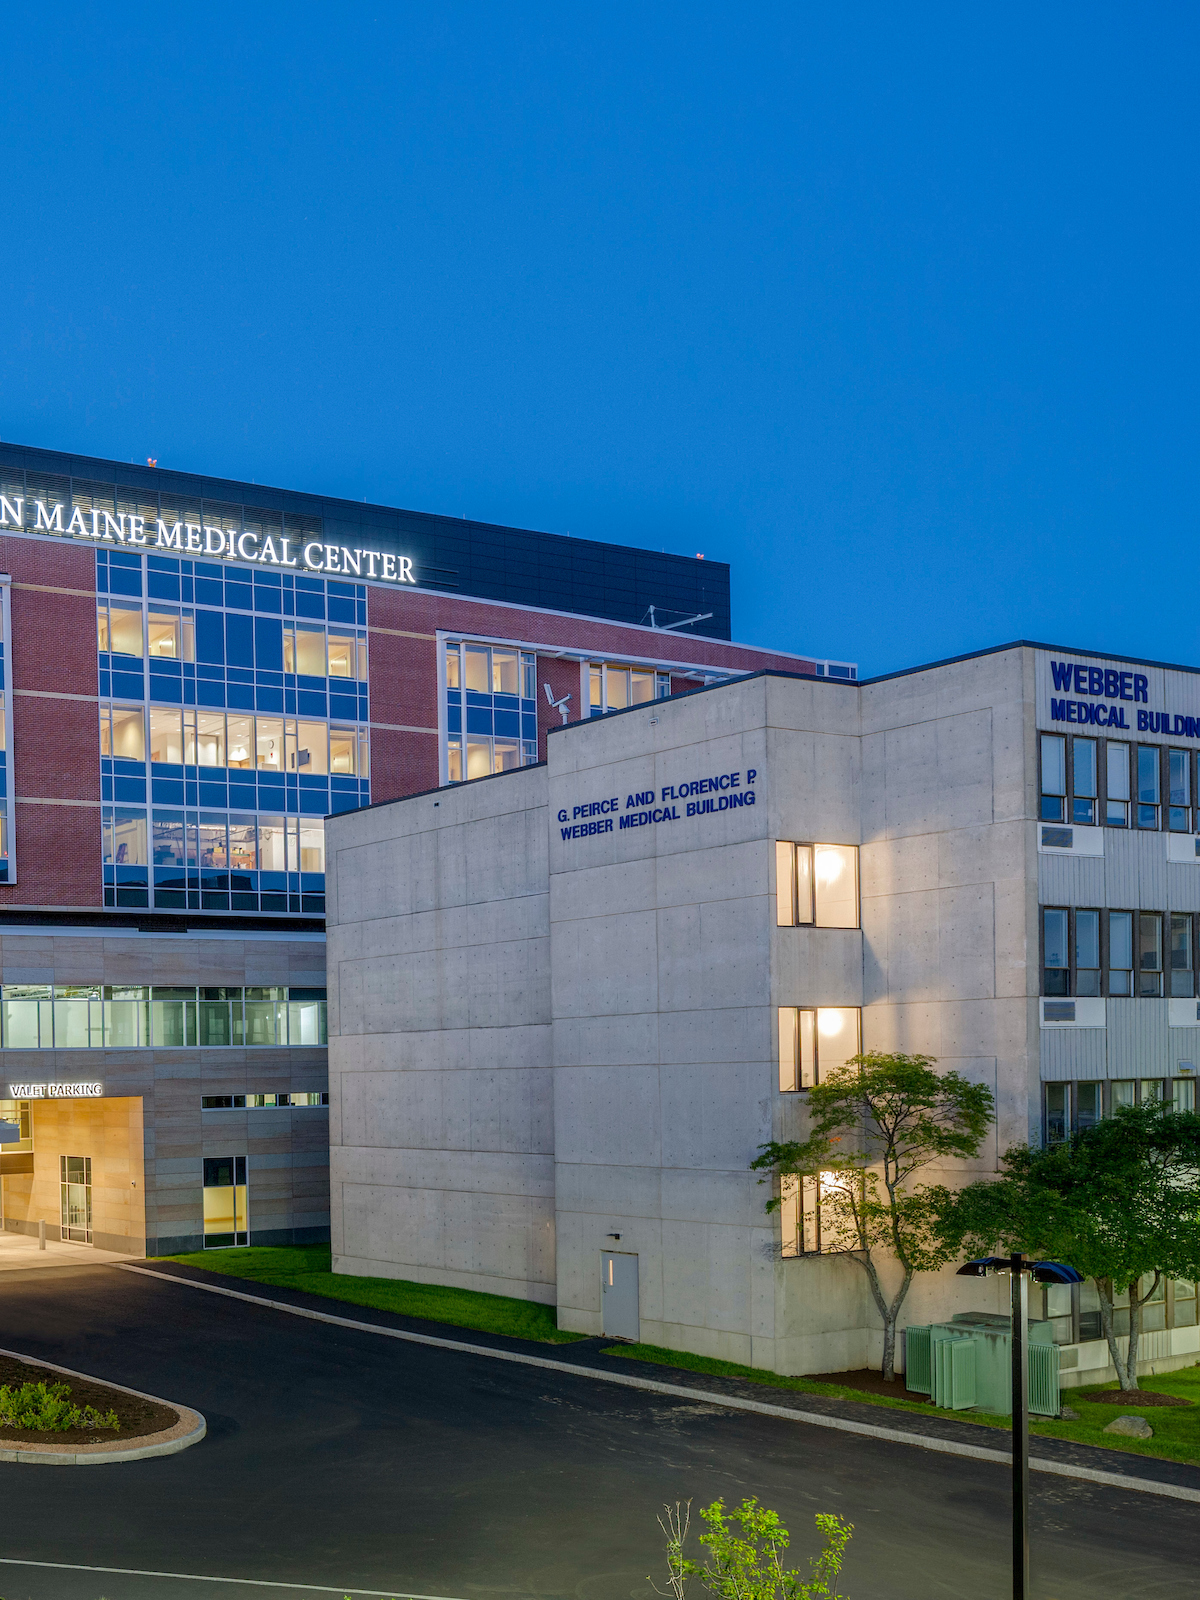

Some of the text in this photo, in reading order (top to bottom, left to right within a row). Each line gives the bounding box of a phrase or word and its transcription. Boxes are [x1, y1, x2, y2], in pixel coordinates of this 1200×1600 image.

[33, 501, 148, 545] MAINE
[155, 519, 297, 567] MEDICAL
[303, 542, 416, 584] CENTER
[1050, 660, 1149, 704] WEBBER
[1050, 697, 1130, 730] MEDICAL
[557, 768, 757, 823] G. PEIRCE AND FLORENCE P.
[560, 790, 756, 841] WEBBER MEDICAL BUILDING
[10, 1083, 102, 1098] VALET PARKING
